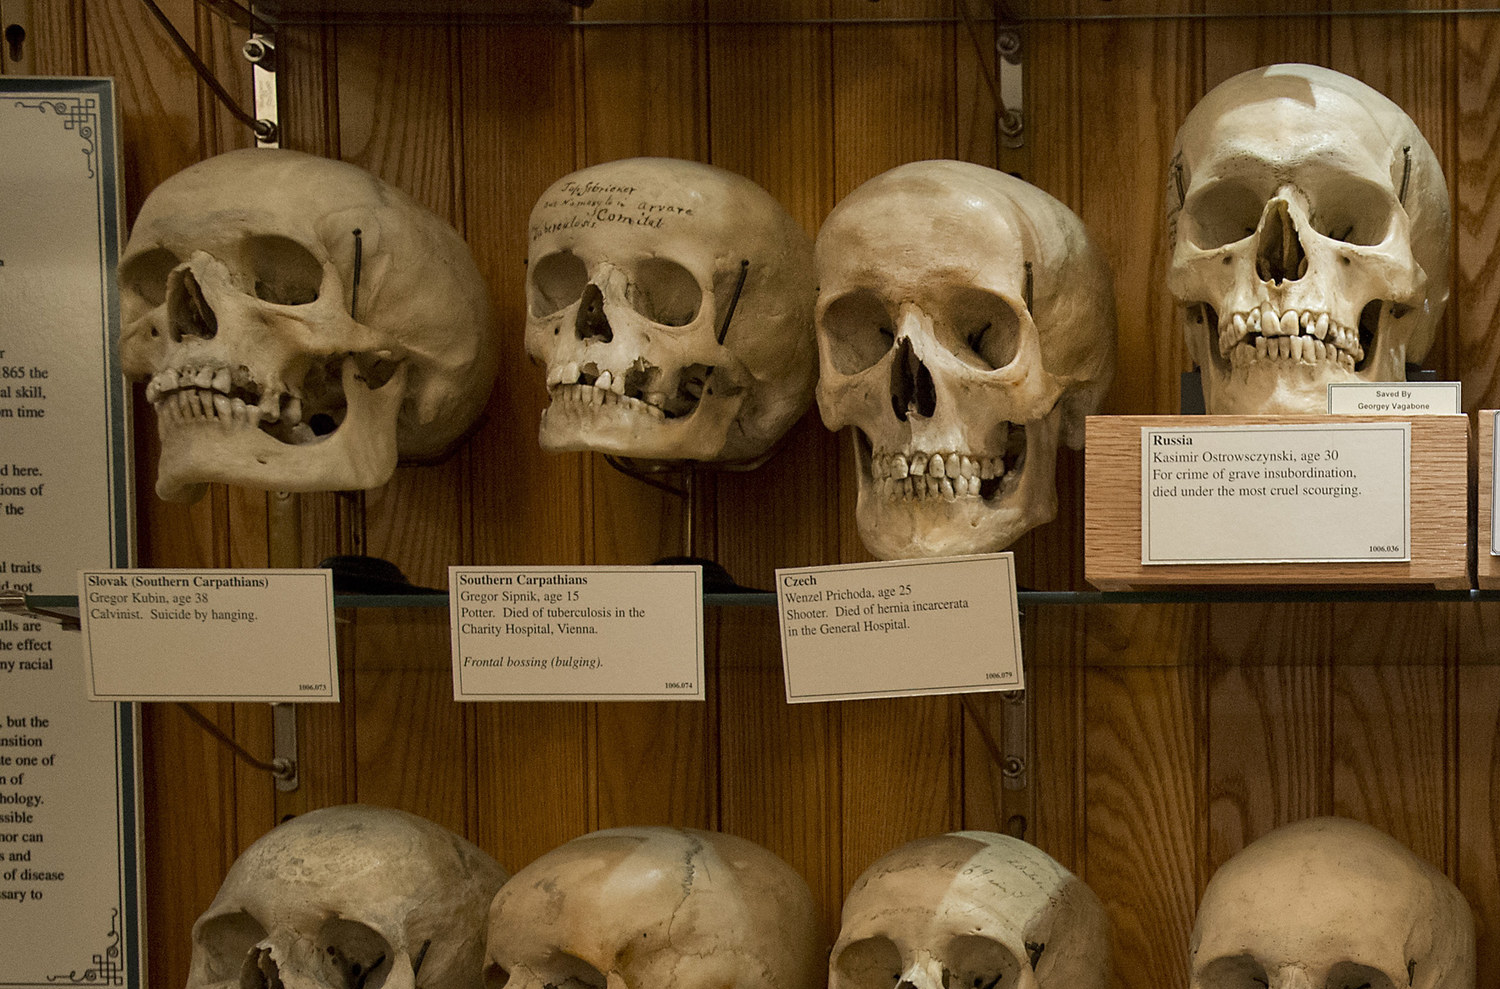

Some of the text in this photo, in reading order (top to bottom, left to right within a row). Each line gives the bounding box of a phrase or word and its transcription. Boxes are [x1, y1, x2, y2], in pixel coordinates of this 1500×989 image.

[28, 367, 48, 379] the
[14, 386, 46, 399] skill,
[1375, 390, 1412, 399] Saved By
[16, 406, 45, 418] time
[1357, 402, 1430, 411] Georgey Vagabone
[1153, 434, 1193, 446] Russia
[1152, 449, 1339, 465] Kasimir Ostrowsczynski, age 30
[12, 464, 43, 477] here.
[1152, 466, 1357, 482] For crime of grave insubordination,
[10, 560, 42, 574] traits
[88, 575, 269, 590] Slovak (Southern Carpathians)
[459, 574, 588, 587] Southern Carpathians
[783, 574, 817, 588] Czech
[88, 592, 209, 606] Gregor Kubin, age 38
[459, 591, 579, 604] Gregor Sipnik, age 15
[784, 584, 912, 603] Wenzel Prichoda, age 25
[89, 608, 258, 623] Calvinist. Suicide by hanging.
[787, 618, 910, 637] in the General Hospital.
[16, 637, 52, 651] effect
[18, 658, 53, 670] racial
[463, 656, 603, 669] Frontal bossing (bulging).
[2, 868, 65, 881] of disease
